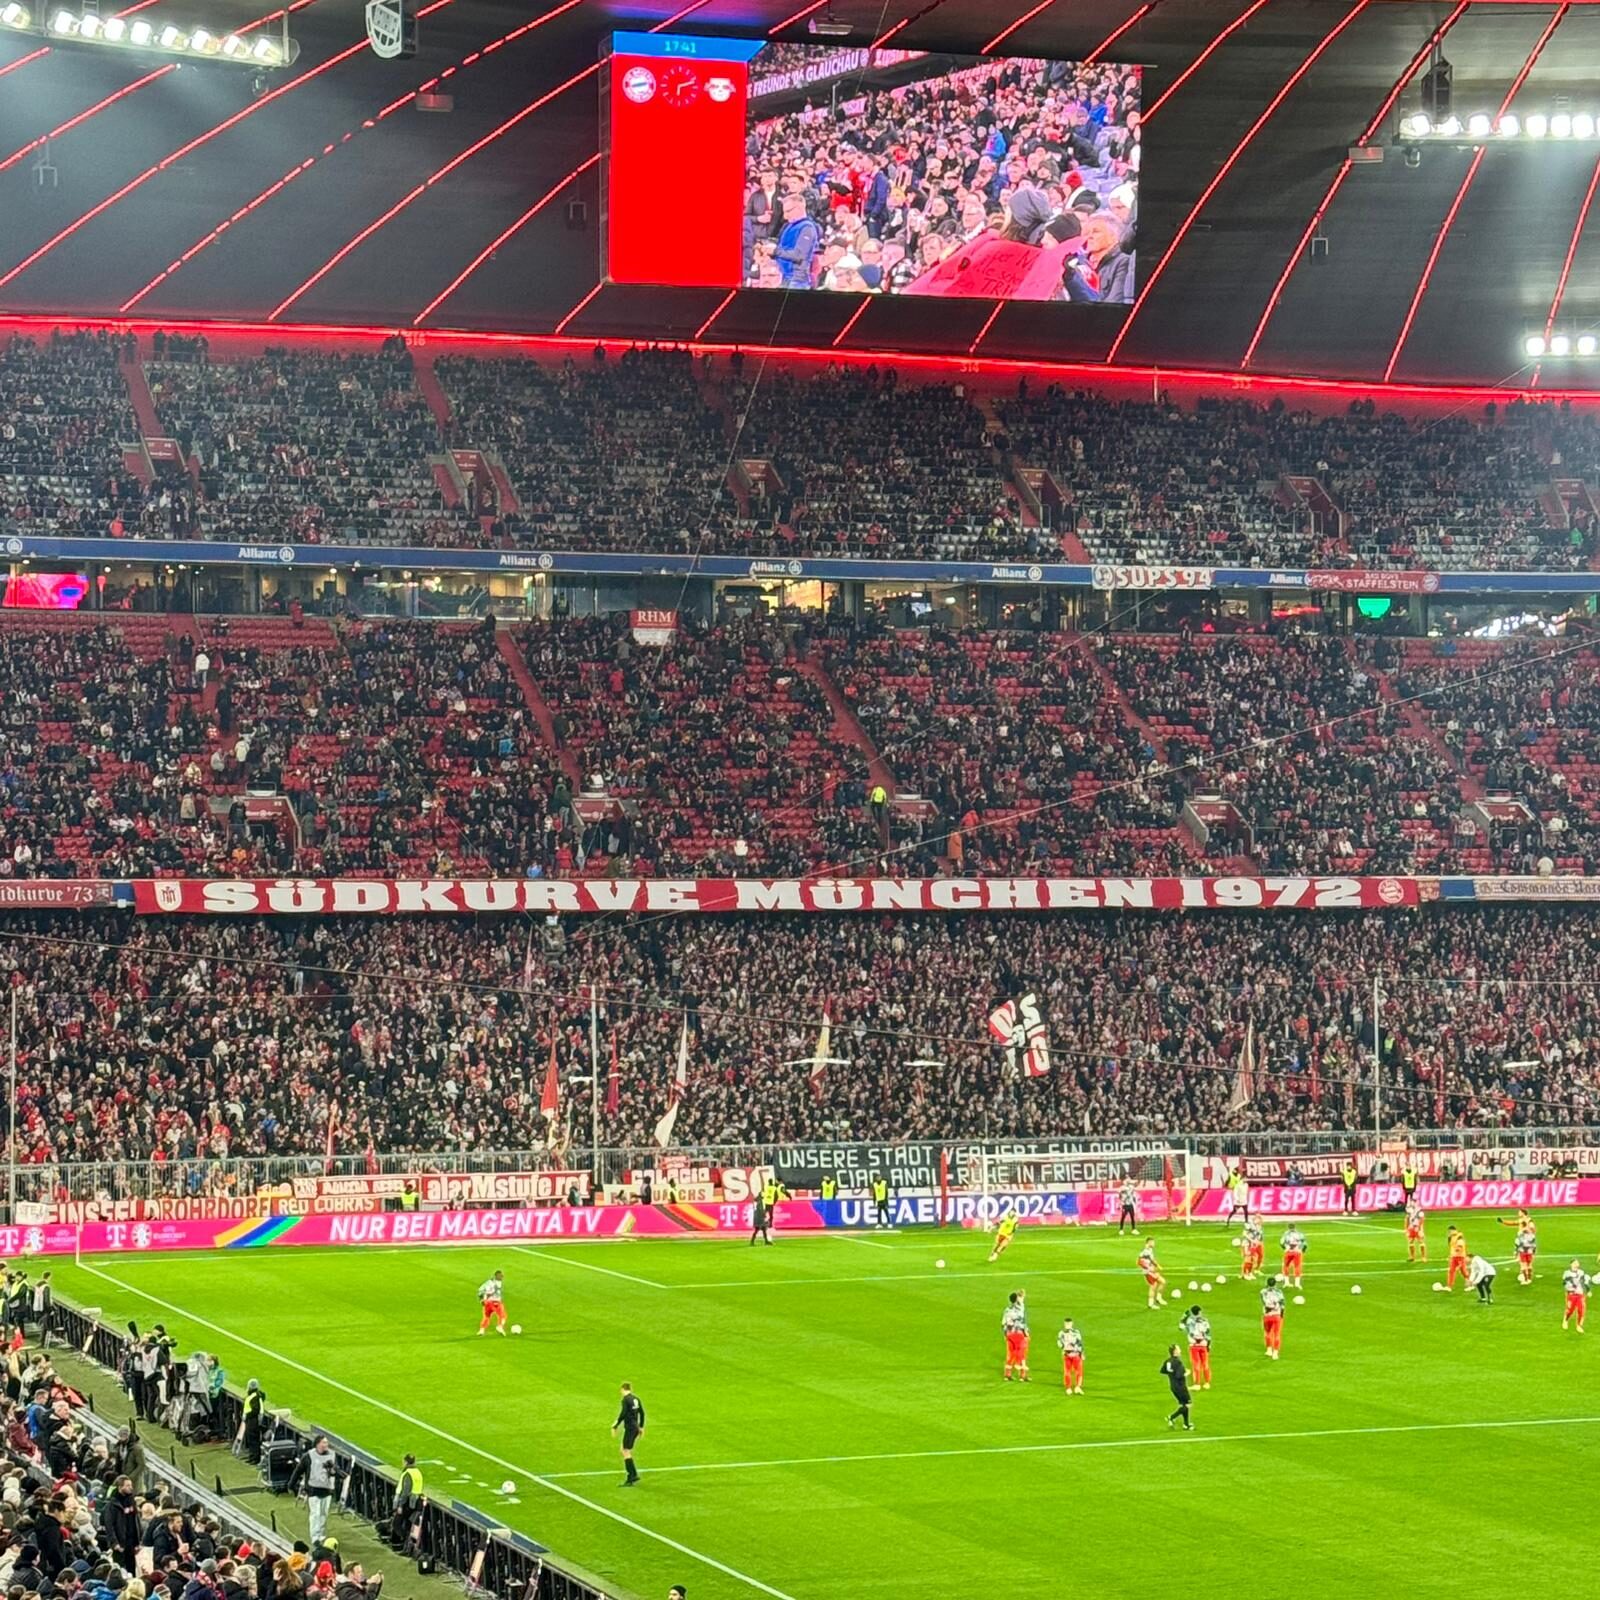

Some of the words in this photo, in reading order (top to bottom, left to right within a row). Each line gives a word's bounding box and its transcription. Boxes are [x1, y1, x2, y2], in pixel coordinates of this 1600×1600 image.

[805, 51, 859, 83] GLAUCHAU
[238, 547, 278, 560] Allianz
[500, 554, 537, 567] Allianz
[750, 561, 786, 574] Allianz
[991, 566, 1027, 579] Allianz
[1116, 567, 1177, 588] SUPS
[1182, 568, 1212, 587] 94
[1268, 572, 1303, 585] Allianz
[637, 610, 672, 623] RHM
[66, 886, 94, 903] '73
[202, 880, 700, 913] SÜDKURVE
[735, 879, 1154, 911] MÜNCHEN
[1178, 878, 1362, 909] 1972
[778, 1149, 859, 1168] UNSERE
[868, 1146, 933, 1167] STADT
[1016, 1165, 1035, 1184] IN
[314, 1197, 375, 1214] COBRAS
[1218, 1190, 1275, 1214] ALE
[1278, 1187, 1346, 1212] SPIEL
[1359, 1185, 1403, 1210] DER
[1413, 1183, 1467, 1208] URO
[1471, 1182, 1527, 1206] 2024
[1530, 1182, 1580, 1206] LIVE
[161, 1198, 269, 1222] ROHRDORF
[330, 1214, 388, 1241] NUR
[391, 1213, 434, 1239] BEI
[438, 1209, 562, 1238] MAGENTA
[569, 1207, 604, 1234] TV
